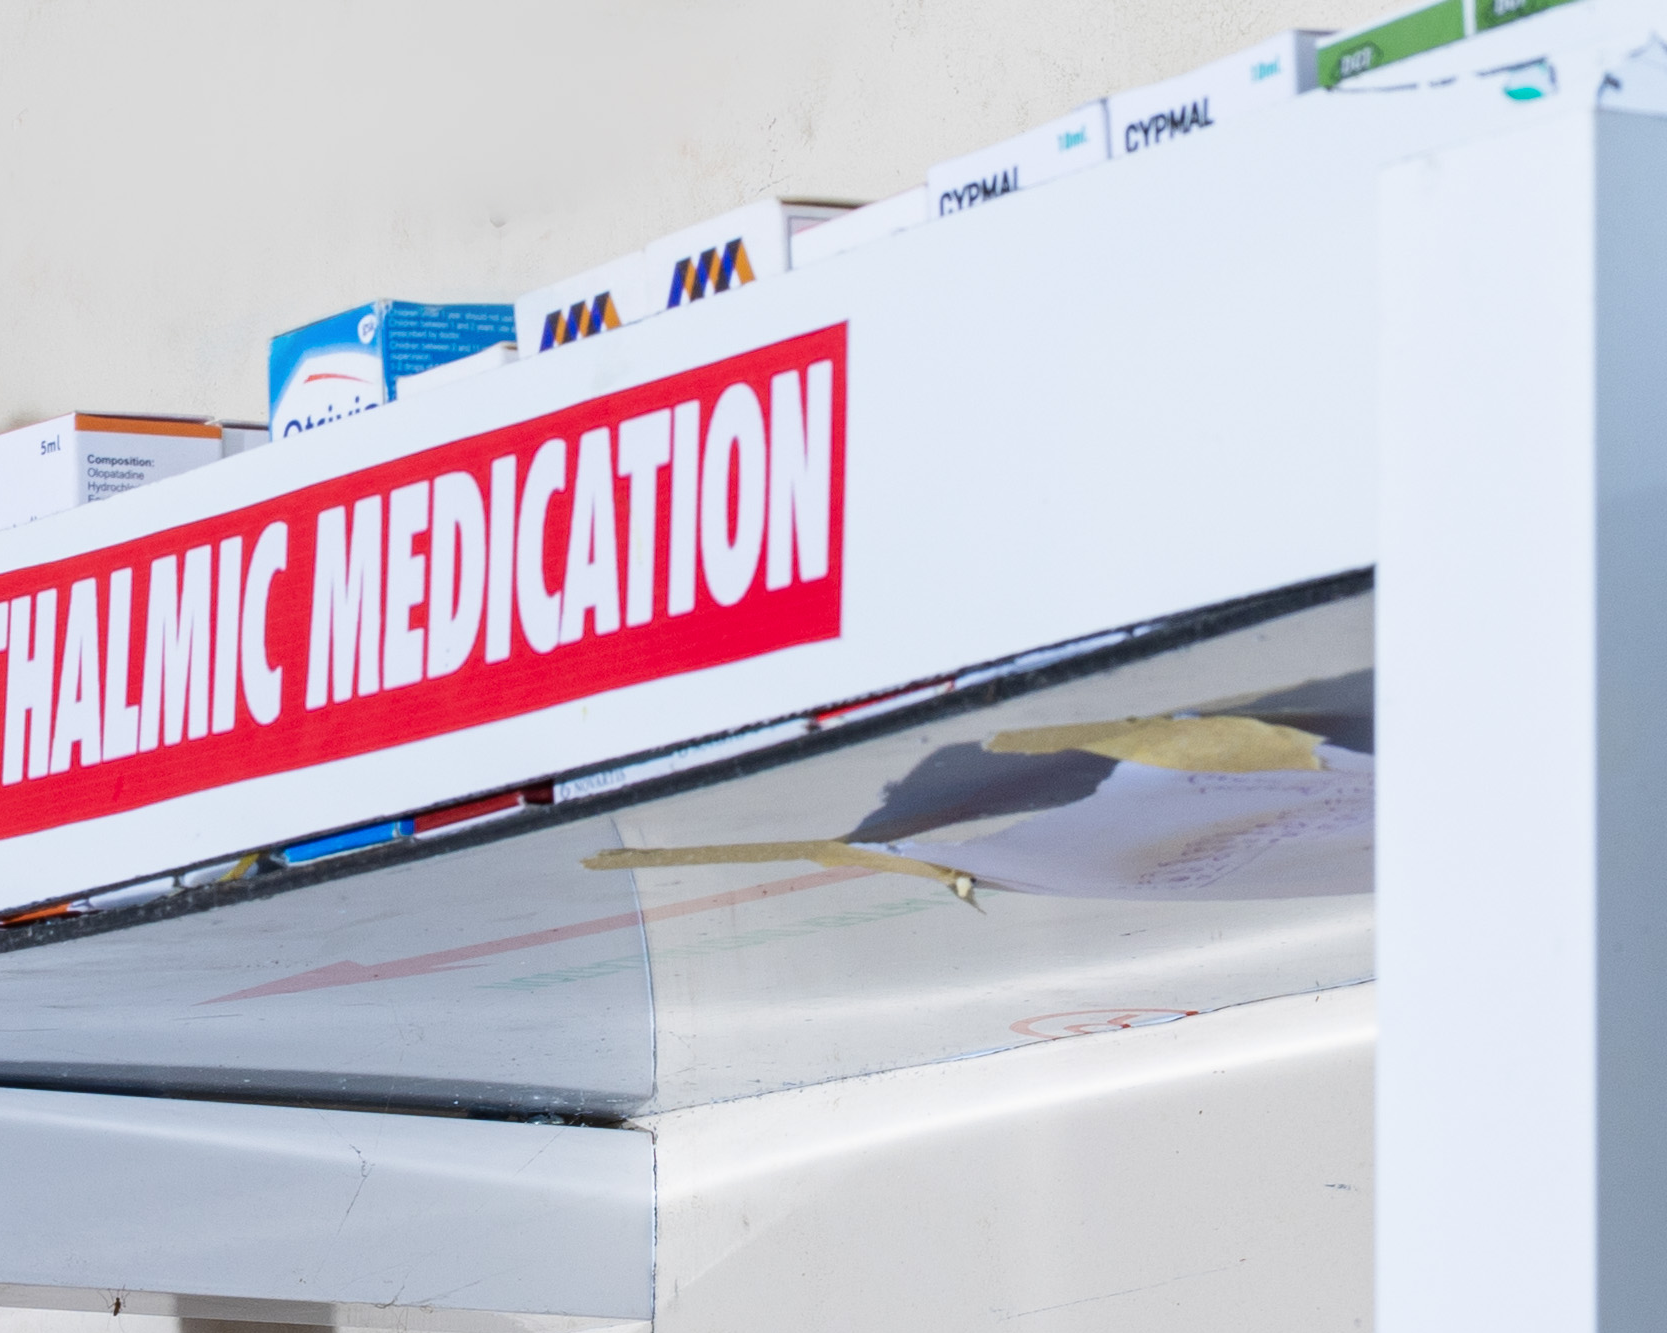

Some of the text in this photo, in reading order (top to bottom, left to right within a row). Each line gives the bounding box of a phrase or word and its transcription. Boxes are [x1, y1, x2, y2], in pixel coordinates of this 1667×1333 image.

[1124, 96, 1215, 154] CYPMAL
[40, 436, 61, 456] 5ml
[87, 453, 155, 470] Composition:
[87, 467, 145, 481] Olopatadine
[303, 360, 835, 713] MEDICATION
